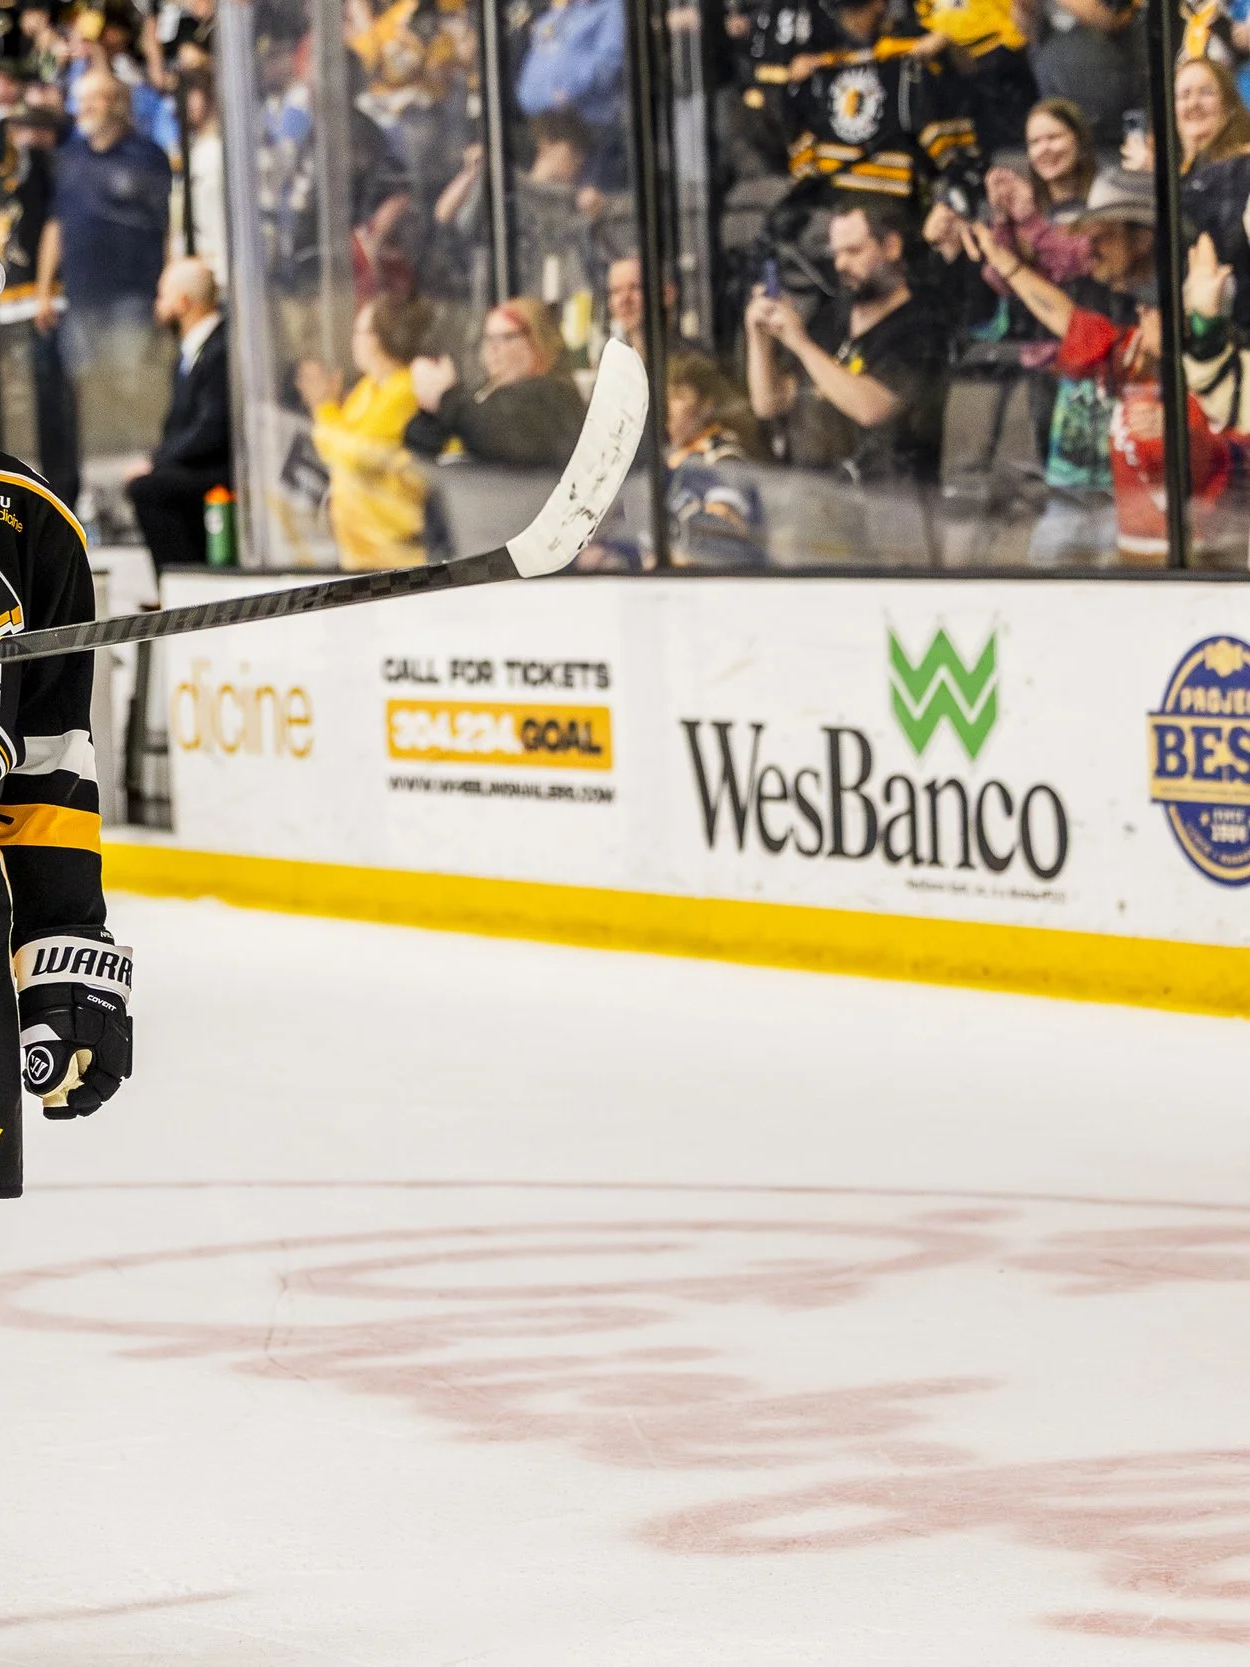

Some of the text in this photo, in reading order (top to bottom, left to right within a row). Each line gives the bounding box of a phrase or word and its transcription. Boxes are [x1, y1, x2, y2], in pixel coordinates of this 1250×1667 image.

[384, 656, 612, 690] CALL FOR TICKETS
[1180, 686, 1250, 716] PROJE
[680, 718, 1069, 881] WesBanco
[86, 993, 117, 1013] COVERT
